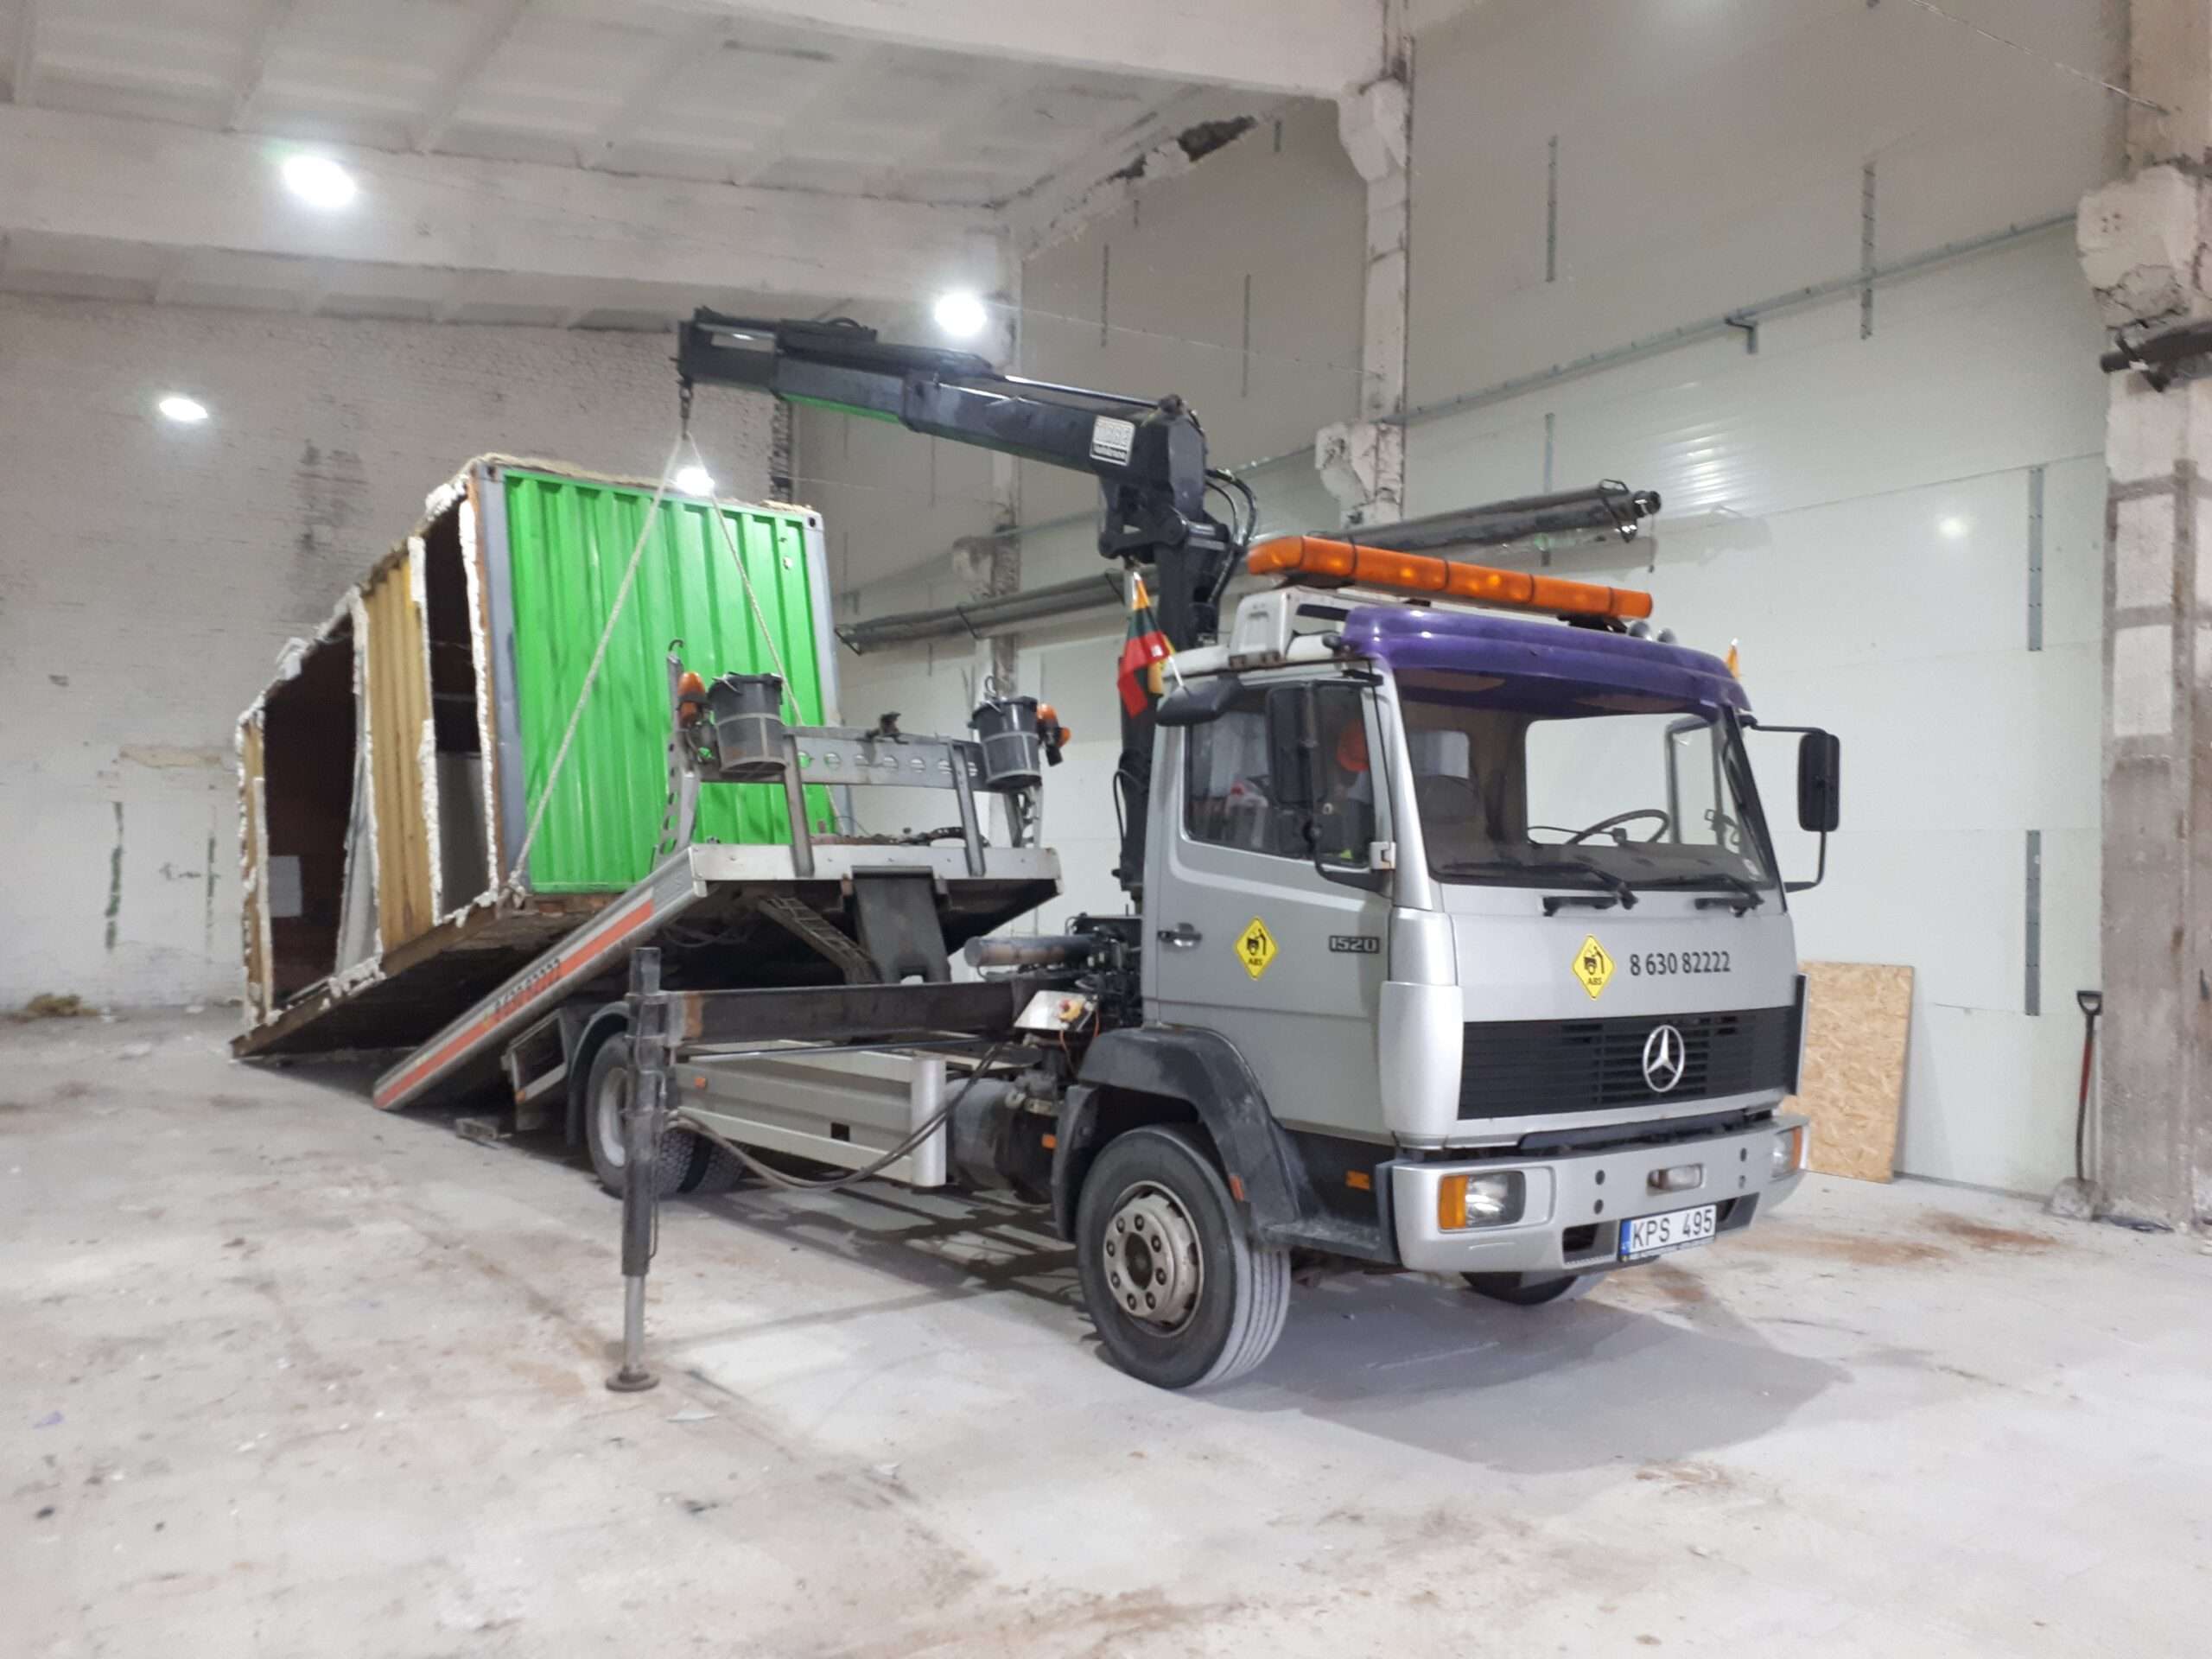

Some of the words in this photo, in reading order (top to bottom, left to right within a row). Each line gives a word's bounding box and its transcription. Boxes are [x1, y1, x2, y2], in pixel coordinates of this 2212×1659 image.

[1332, 937, 1378, 952] 1520
[1249, 957, 1263, 966] ABS
[1630, 954, 1641, 976] 8
[1646, 952, 1677, 976] 630
[1682, 950, 1731, 974] 82222
[1587, 977, 1602, 986] ABS
[1632, 1217, 1670, 1249] KPS
[1682, 1209, 1713, 1237] 495
